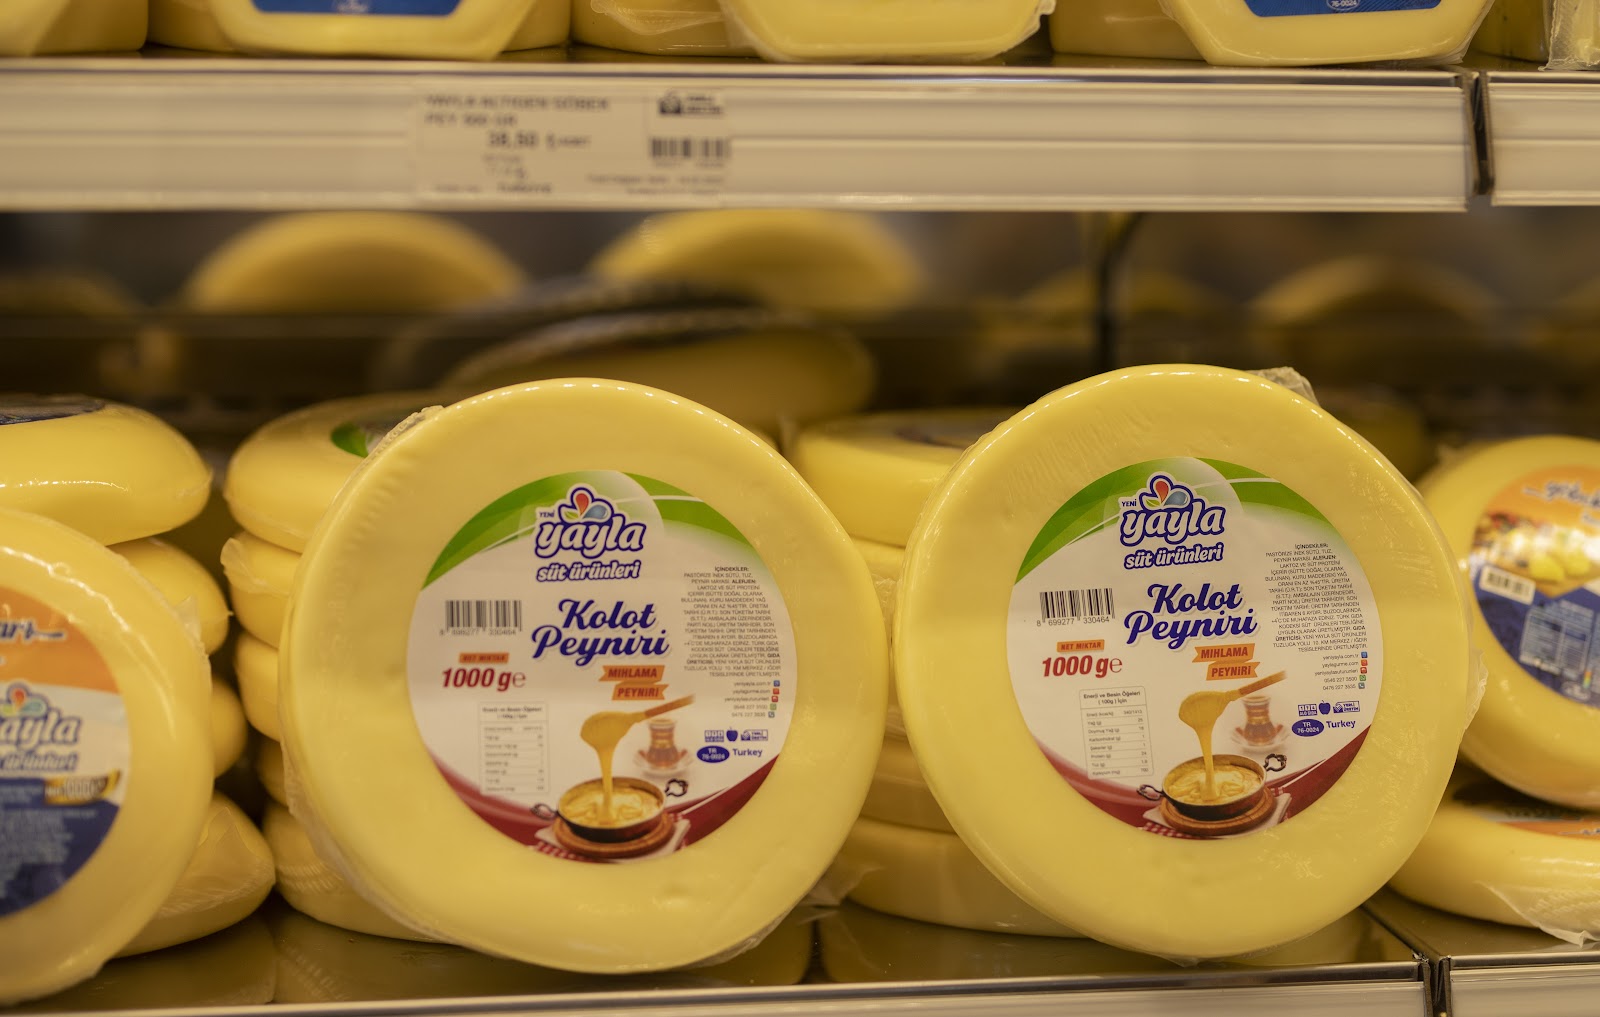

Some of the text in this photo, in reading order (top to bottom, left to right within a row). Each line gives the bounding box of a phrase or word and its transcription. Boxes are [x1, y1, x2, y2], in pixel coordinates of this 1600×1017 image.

[538, 509, 555, 518] YENİ
[1121, 499, 1137, 508] YENİ
[1120, 498, 1226, 547] yayla
[535, 514, 647, 559] yayla
[1124, 542, 1224, 570] süt ürünleri
[537, 560, 642, 582] süt ürünleri
[1147, 583, 1243, 614] Kolot
[558, 598, 656, 630] Kolot
[1048, 618, 1075, 626] 699277
[1083, 616, 1110, 624] 330464
[1124, 608, 1257, 650] Peyniri
[532, 625, 669, 666] Peyniri
[1200, 646, 1249, 660] MIHLAMA
[607, 668, 657, 679] MIHLAMA
[1042, 655, 1094, 677] 1000
[442, 668, 495, 688] 1000
[1326, 720, 1356, 729] Turkey
[732, 749, 764, 758] Turkey
